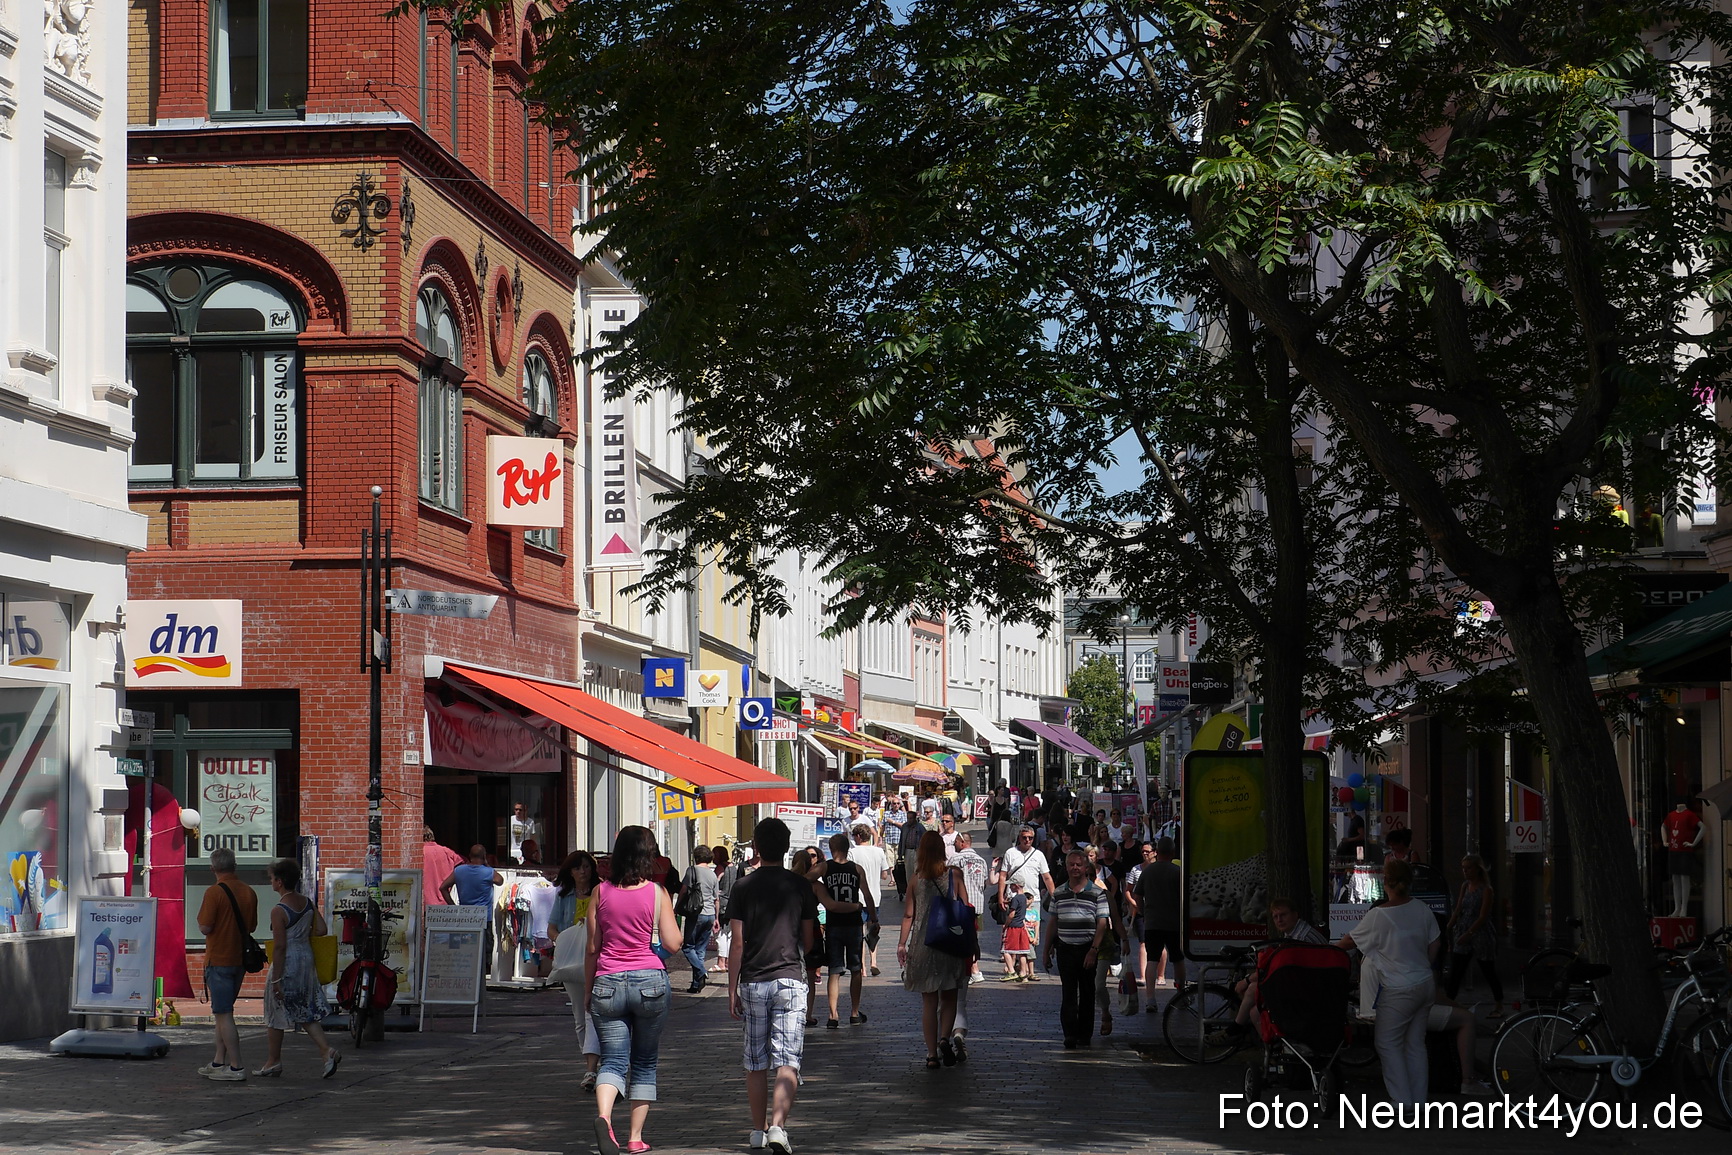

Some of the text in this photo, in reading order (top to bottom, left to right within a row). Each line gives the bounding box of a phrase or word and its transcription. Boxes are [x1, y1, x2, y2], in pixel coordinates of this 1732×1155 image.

[270, 312, 290, 328] Ryf
[274, 353, 288, 464] FRISEUR SALON
[603, 414, 626, 524] BRILLEN
[497, 451, 561, 509] Ryf
[417, 594, 473, 606] NORDDEUTSCHES
[417, 603, 457, 612] ANTIQUARIAT
[150, 613, 218, 654] dm
[1163, 668, 1188, 677] Bea
[1166, 679, 1189, 688] Uhs
[759, 731, 796, 740] FRISEUR
[203, 757, 270, 775] OUTLET
[203, 782, 269, 802] Catwalk
[1224, 792, 1250, 803] 4.500
[203, 834, 270, 852] OUTLET
[826, 873, 858, 888] REVOLT
[380, 899, 408, 910] unkel“
[428, 905, 458, 914] Besuchen
[460, 906, 470, 914] Sie
[90, 912, 144, 925] Testsieger
